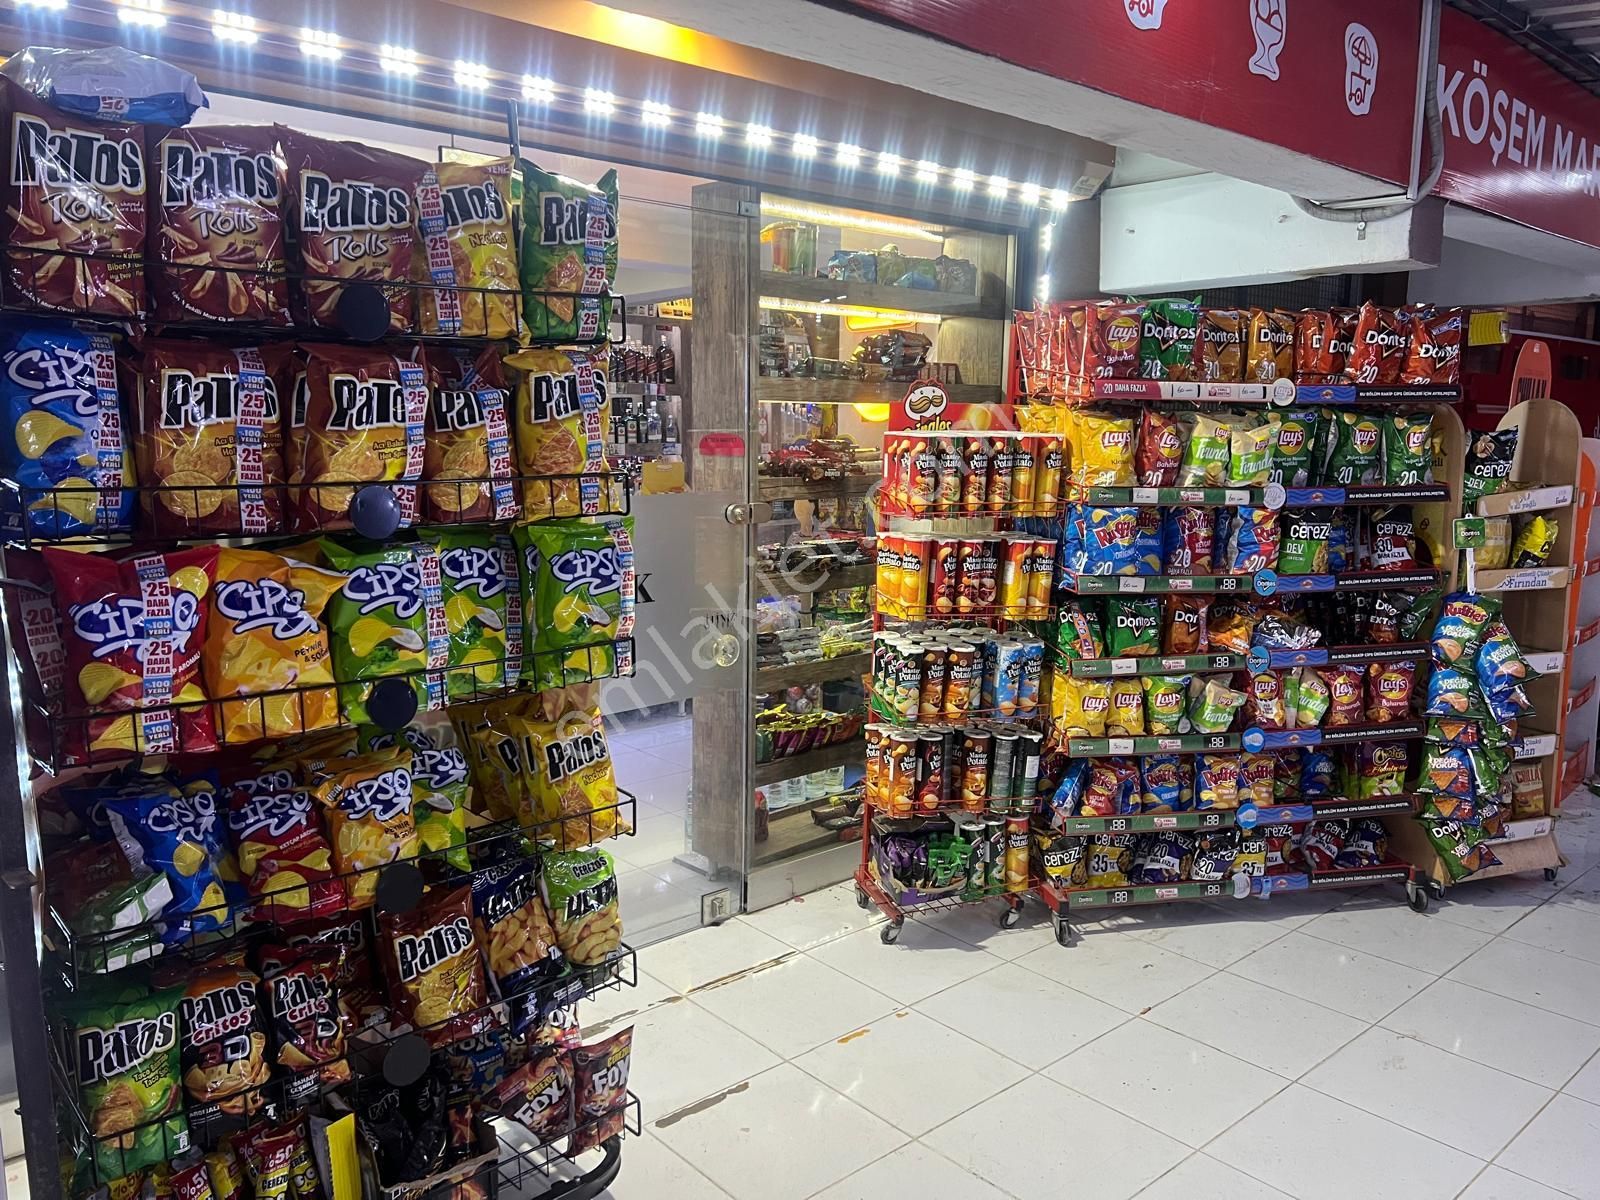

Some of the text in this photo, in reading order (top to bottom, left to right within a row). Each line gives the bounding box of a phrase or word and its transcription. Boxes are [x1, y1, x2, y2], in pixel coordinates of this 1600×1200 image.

[1437, 59, 1546, 172] KÖŞEM
[324, 234, 388, 262] Rolls
[1143, 323, 1196, 339] Doritos
[1203, 330, 1239, 343] Doritos
[98, 381, 116, 389] FAZLA
[1115, 384, 1130, 392] DAHA
[1130, 384, 1146, 392] FAZLA
[240, 418, 262, 426] FAZLA
[1279, 431, 1303, 447] Lay's
[1286, 543, 1304, 554] DEV
[138, 558, 162, 566] FAZLA
[146, 609, 170, 617] FAZLA
[899, 673, 921, 681] Potato
[950, 671, 972, 679] Potato
[1083, 696, 1108, 713] Lay's
[967, 757, 988, 765] Potato
[1203, 768, 1238, 787] Ruffle
[591, 1057, 630, 1097] FOX
[514, 1078, 566, 1126] FOX
